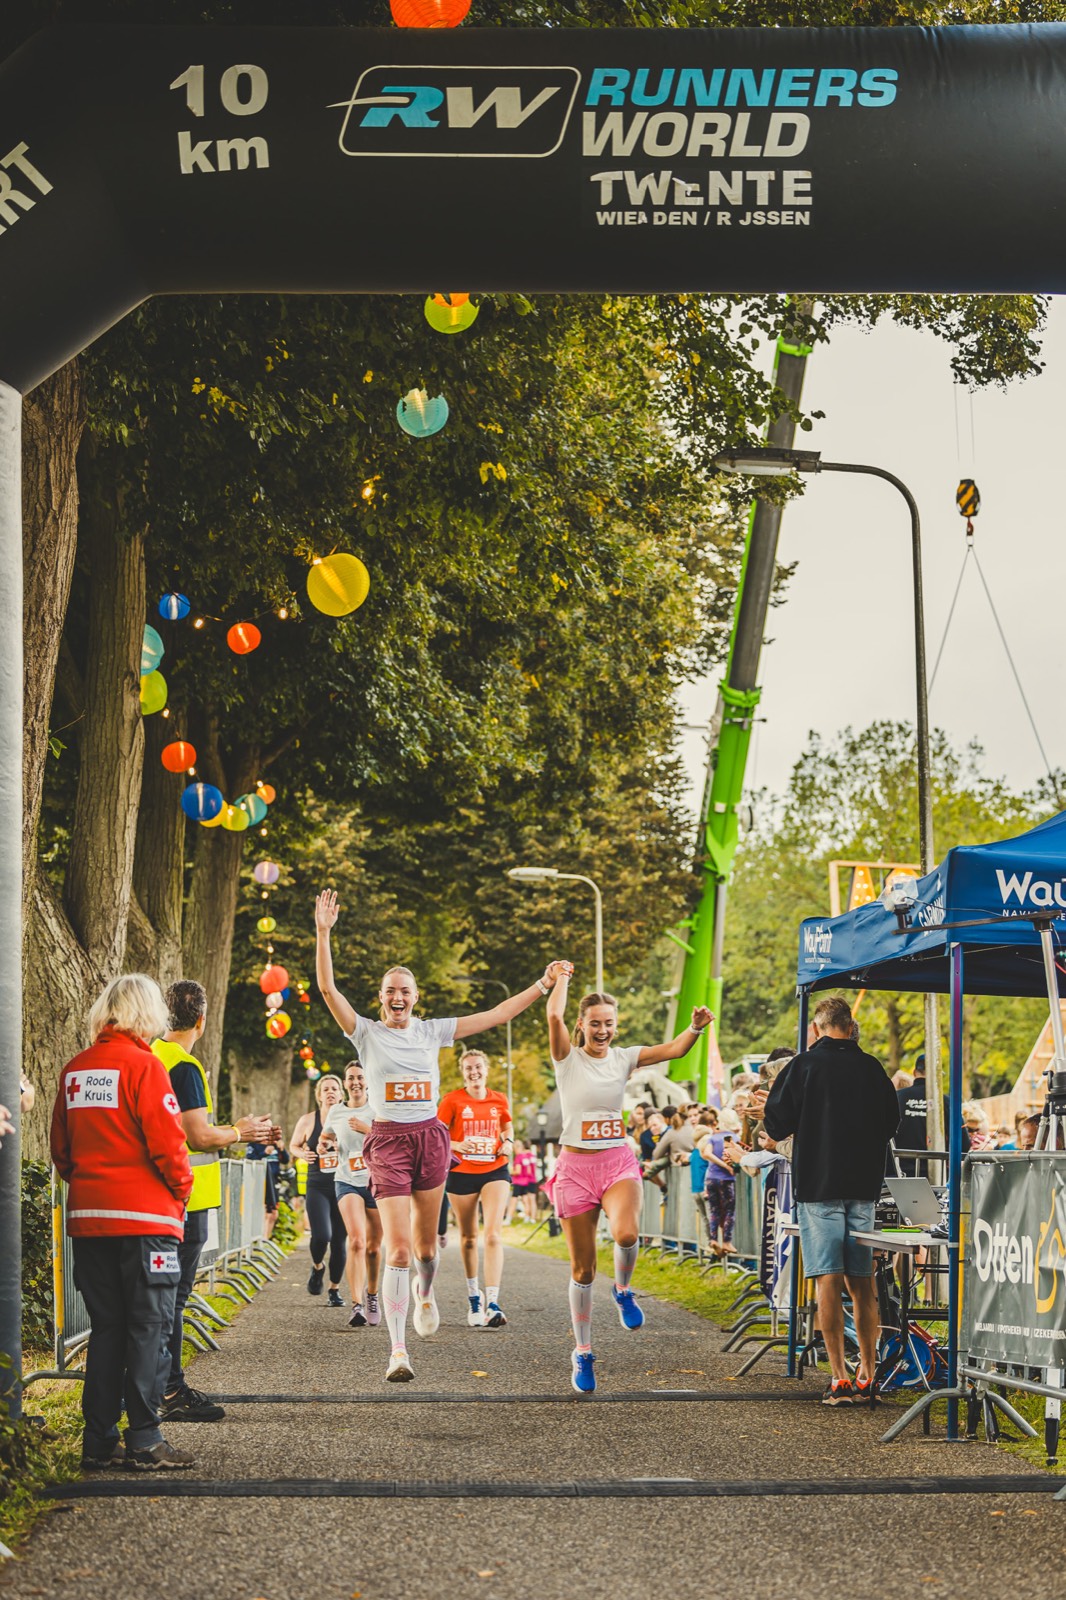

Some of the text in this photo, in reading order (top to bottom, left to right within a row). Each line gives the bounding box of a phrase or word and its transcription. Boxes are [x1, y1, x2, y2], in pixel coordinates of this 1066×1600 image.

[170, 64, 269, 117] 10
[359, 86, 562, 128] RW
[585, 68, 899, 107] RUNNERS
[177, 131, 270, 174] km
[582, 112, 810, 157] WORLD
[0, 141, 54, 236] RT
[590, 170, 813, 206] TWENTE
[84, 1089, 113, 1102] Kruis
[85, 1076, 113, 1087] Rode
[394, 1083, 426, 1100] 541
[586, 1120, 622, 1138] 465
[323, 1156, 338, 1168] 57
[765, 1186, 778, 1285] GARMIN
[973, 1218, 1034, 1285] Otten
